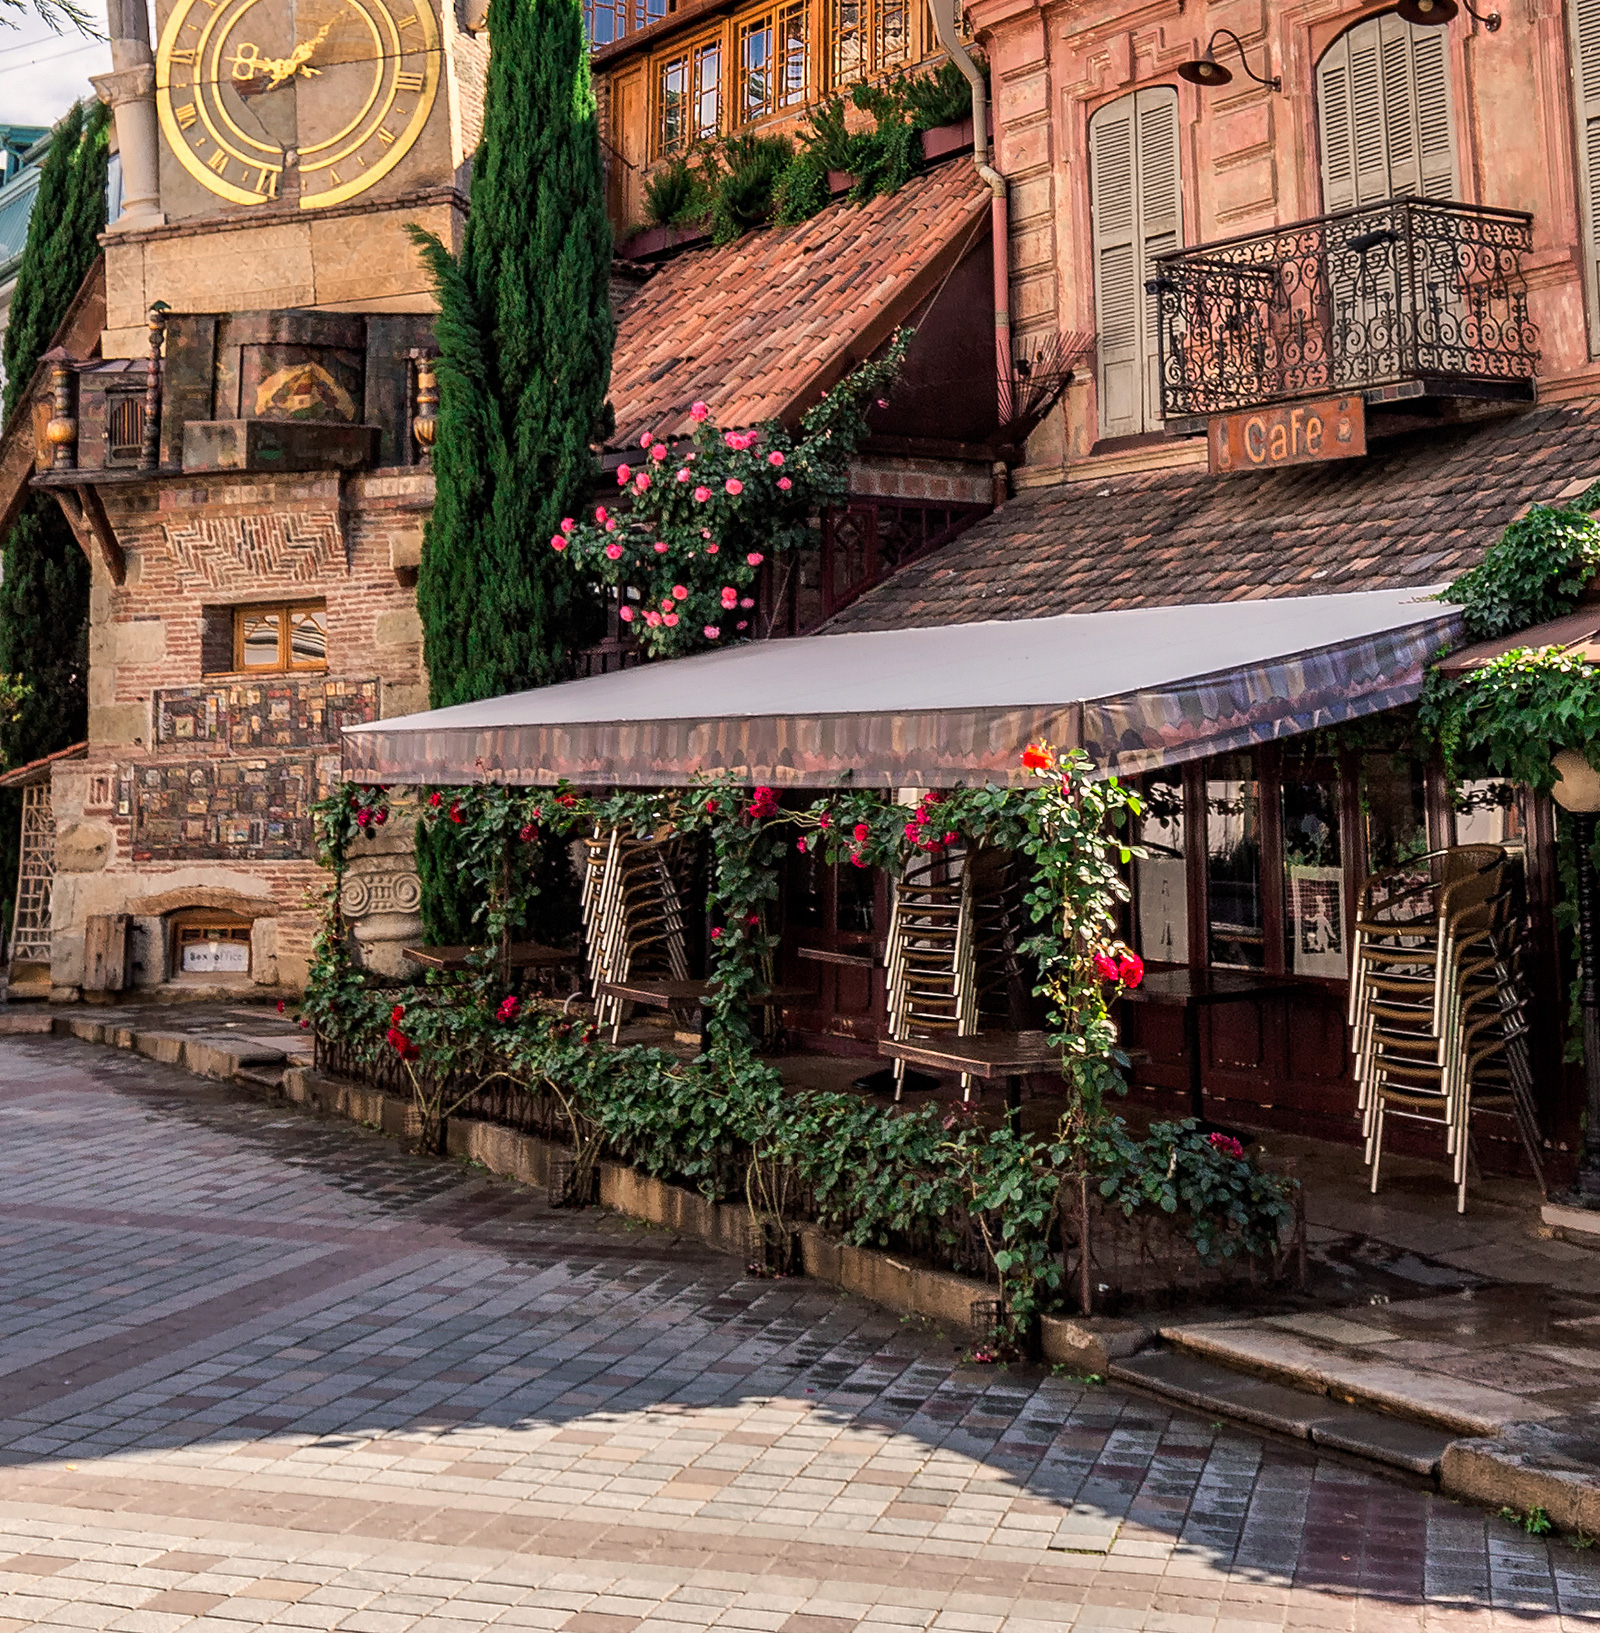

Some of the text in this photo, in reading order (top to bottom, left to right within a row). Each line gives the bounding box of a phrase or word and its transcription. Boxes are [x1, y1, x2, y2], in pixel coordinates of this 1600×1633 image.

[398, 14, 417, 30] II
[395, 70, 424, 91] III
[330, 168, 342, 186] V
